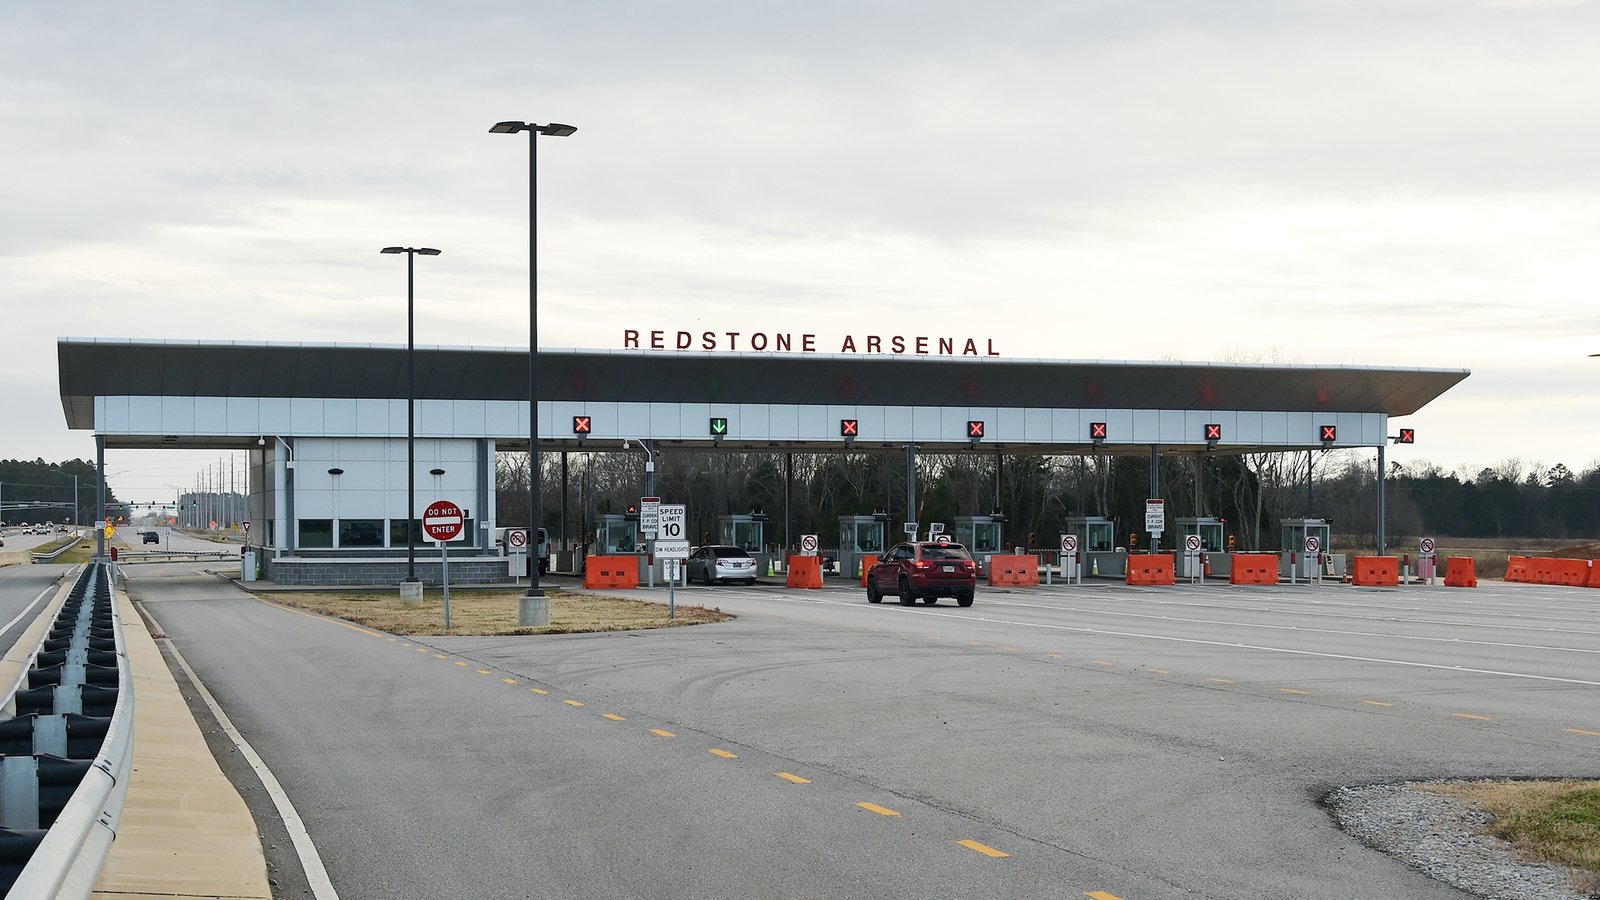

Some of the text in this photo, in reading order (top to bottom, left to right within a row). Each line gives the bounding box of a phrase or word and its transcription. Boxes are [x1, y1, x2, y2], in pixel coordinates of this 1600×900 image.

[624, 329, 999, 356] REDSTONE ARSENAL
[662, 523, 680, 536] 10
